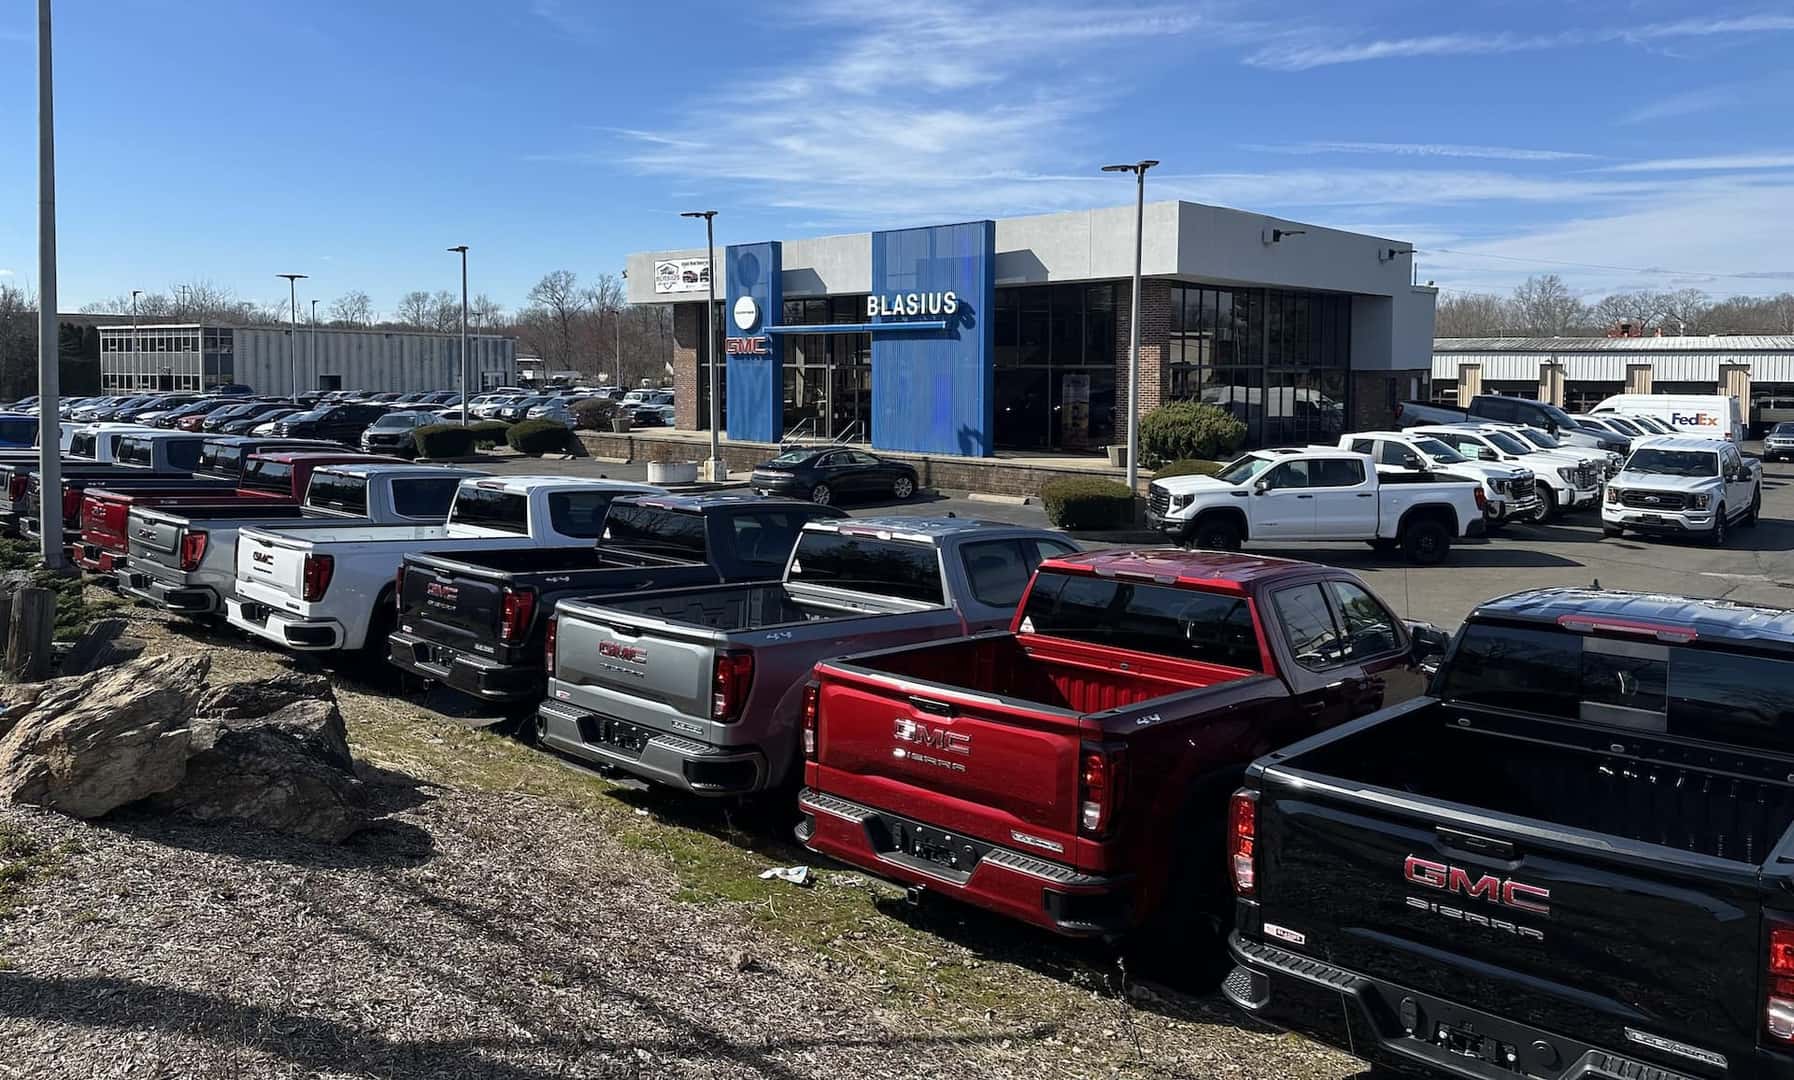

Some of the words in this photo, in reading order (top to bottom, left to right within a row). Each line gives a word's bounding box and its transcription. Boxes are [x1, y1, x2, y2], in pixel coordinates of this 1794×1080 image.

[867, 291, 956, 316] BLASIUS
[725, 336, 768, 354] GMC
[1671, 412, 1718, 426] FedEx
[253, 551, 274, 565] GMC
[427, 582, 458, 600] GMC
[599, 640, 648, 665] GMC
[894, 718, 971, 754] GMC
[1404, 853, 1550, 914] GMC
[1406, 896, 1545, 940] SIERRA
